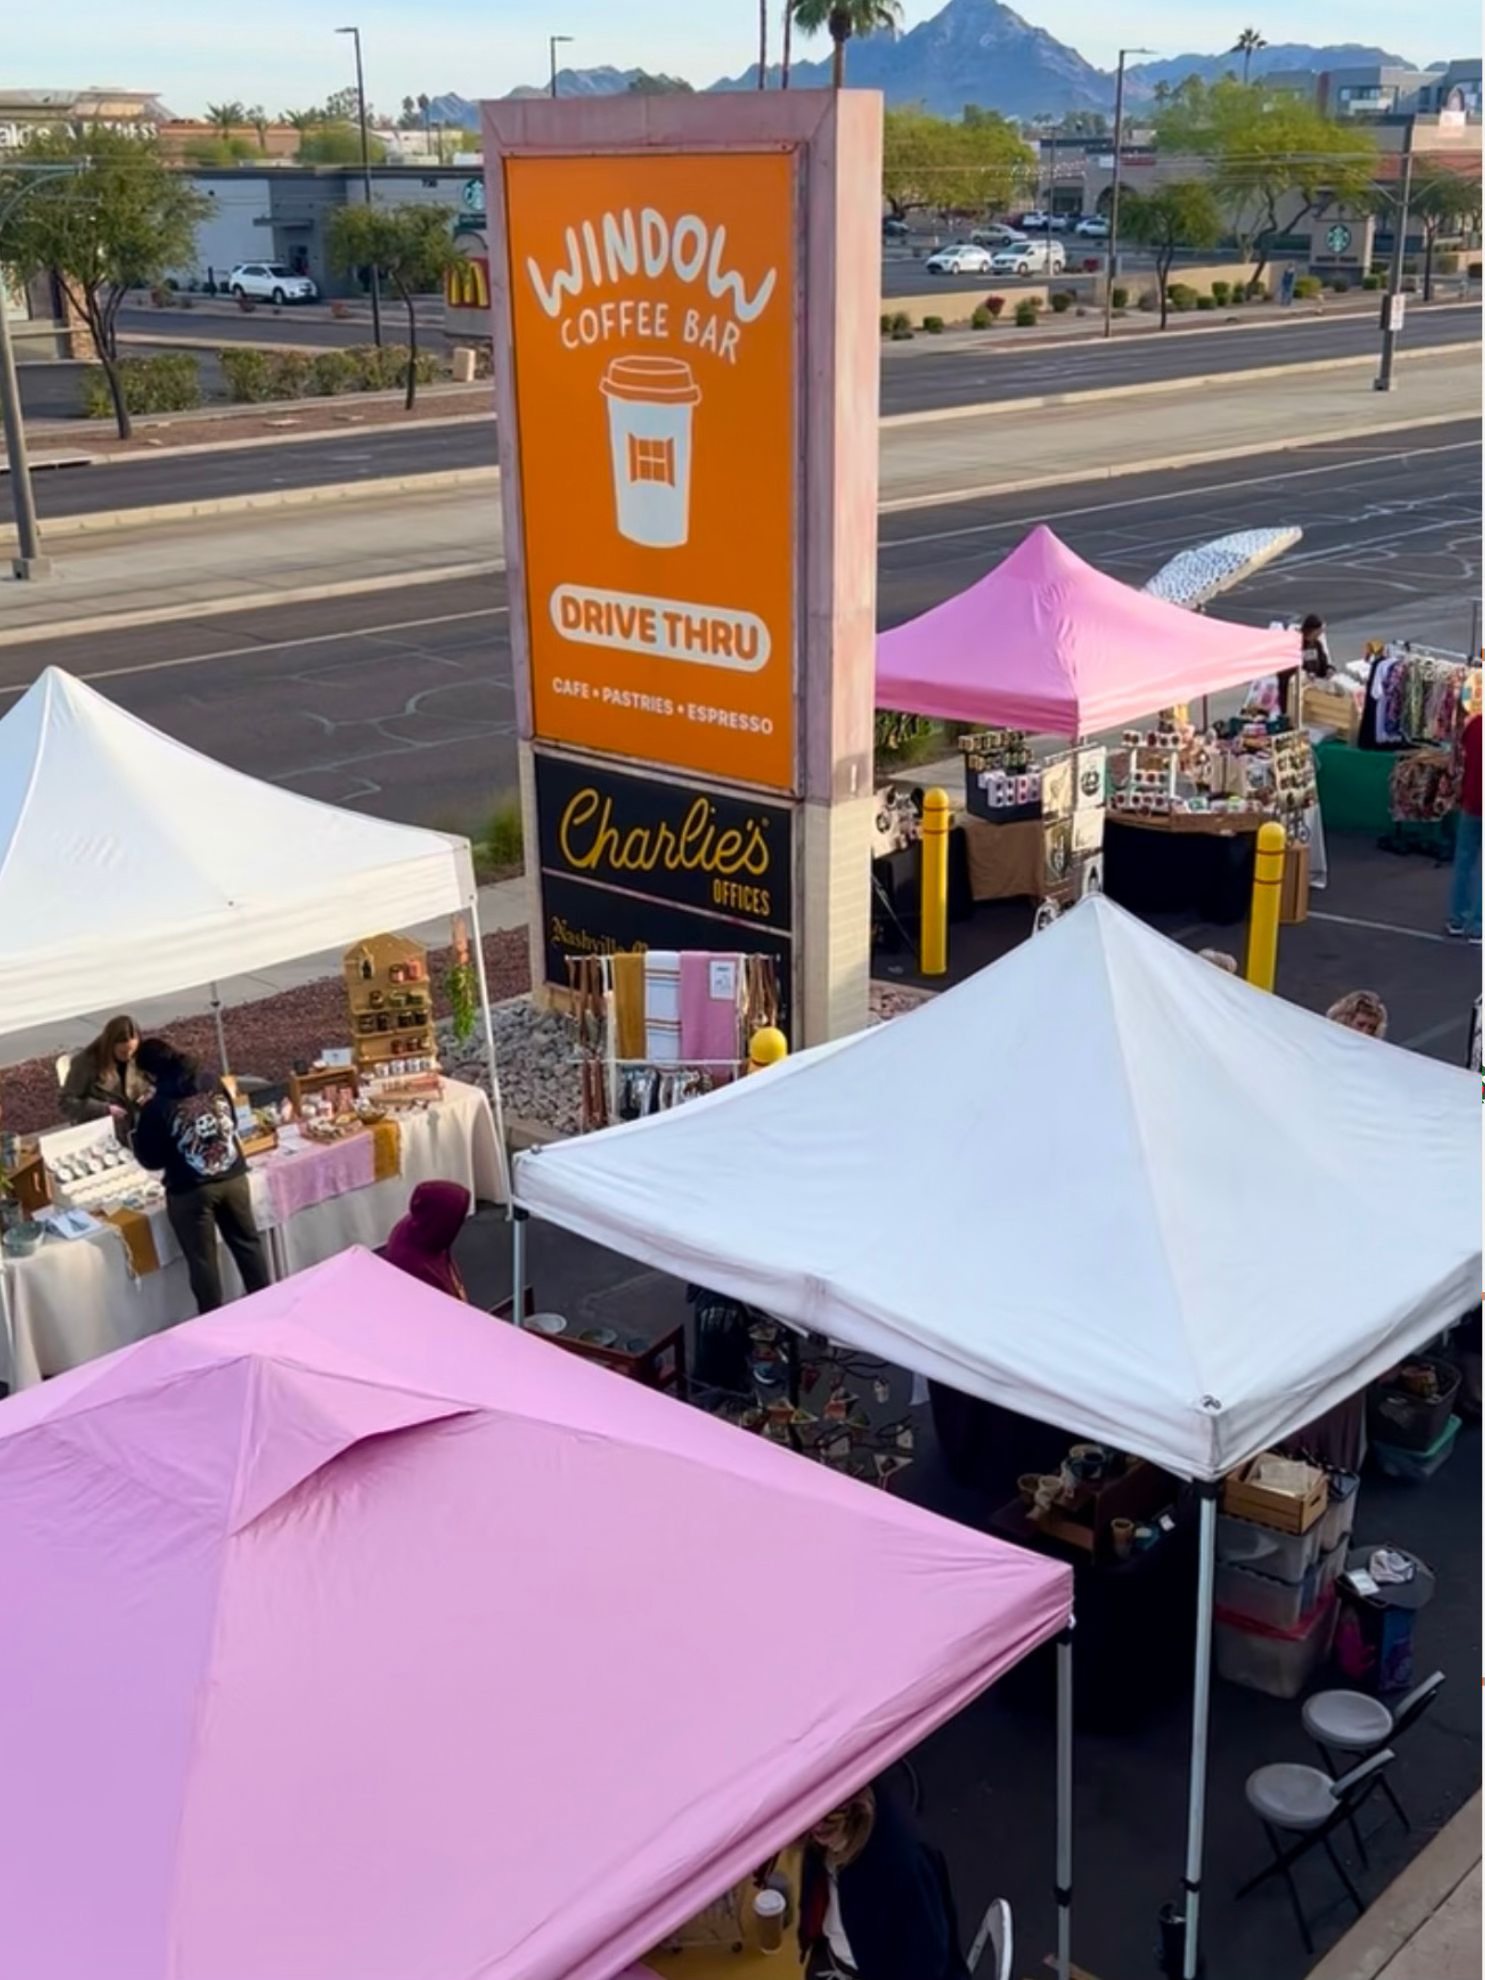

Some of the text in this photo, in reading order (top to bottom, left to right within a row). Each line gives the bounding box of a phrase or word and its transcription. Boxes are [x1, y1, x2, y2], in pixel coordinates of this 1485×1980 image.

[526, 207, 777, 323] WINDOW
[561, 300, 741, 365] COFFEE BAR
[560, 594, 759, 661] DRIVE THRU
[552, 676, 774, 736] CAFE PASTRIES ESPRESSO
[560, 787, 769, 876] Charlie's
[712, 878, 770, 917] OFFICES
